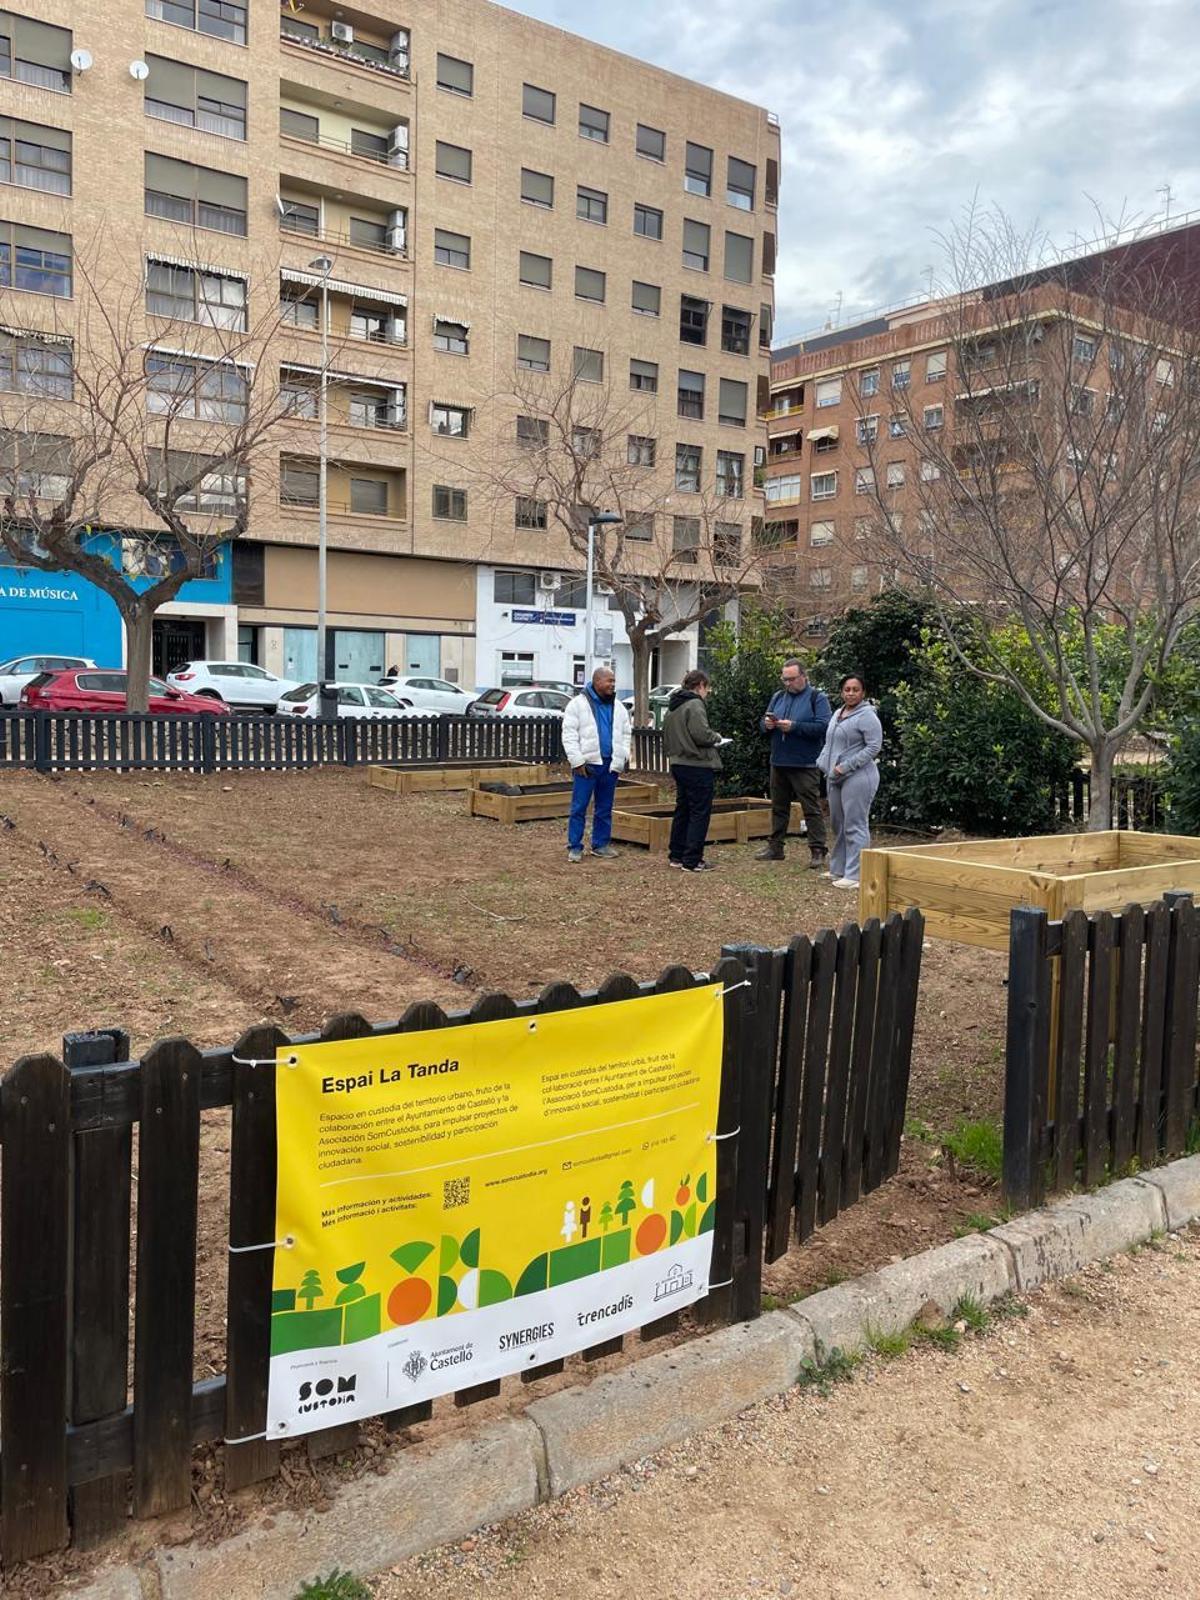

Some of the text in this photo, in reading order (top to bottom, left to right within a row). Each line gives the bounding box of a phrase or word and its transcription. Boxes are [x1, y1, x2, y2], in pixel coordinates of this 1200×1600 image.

[9, 588, 27, 598] DE
[30, 587, 78, 600] MÚSICA
[321, 1058, 460, 1094] Espai La Tanda
[320, 1112, 354, 1122] Espacio
[356, 1110, 366, 1118] en
[368, 1104, 401, 1116] custodia
[402, 1100, 414, 1110] del
[416, 1095, 446, 1106] territorio
[475, 1086, 492, 1095] fruto
[493, 1084, 502, 1092] de
[504, 1082, 511, 1090] la
[320, 1121, 374, 1133] colaboración
[376, 1118, 394, 1127] entre
[396, 1114, 404, 1122] el
[406, 1105, 456, 1122] Ayuntamiento
[456, 1102, 466, 1111] de
[502, 1094, 510, 1102] la
[318, 1145, 364, 1158] innovación
[394, 1130, 446, 1148] sostenibilidad
[452, 1120, 498, 1137] participación
[319, 1134, 366, 1146] Asociación
[424, 1120, 440, 1130] para
[442, 1114, 472, 1126] impulsar
[474, 1108, 508, 1120] proyectos
[508, 1104, 518, 1112] de
[336, 1200, 380, 1214] información
[337, 1208, 376, 1222] informació
[500, 1322, 554, 1350] SYNERGIES
[430, 1342, 474, 1359] Ajuntament de
[430, 1349, 474, 1372] Castelló
[298, 1374, 356, 1402] SOM
